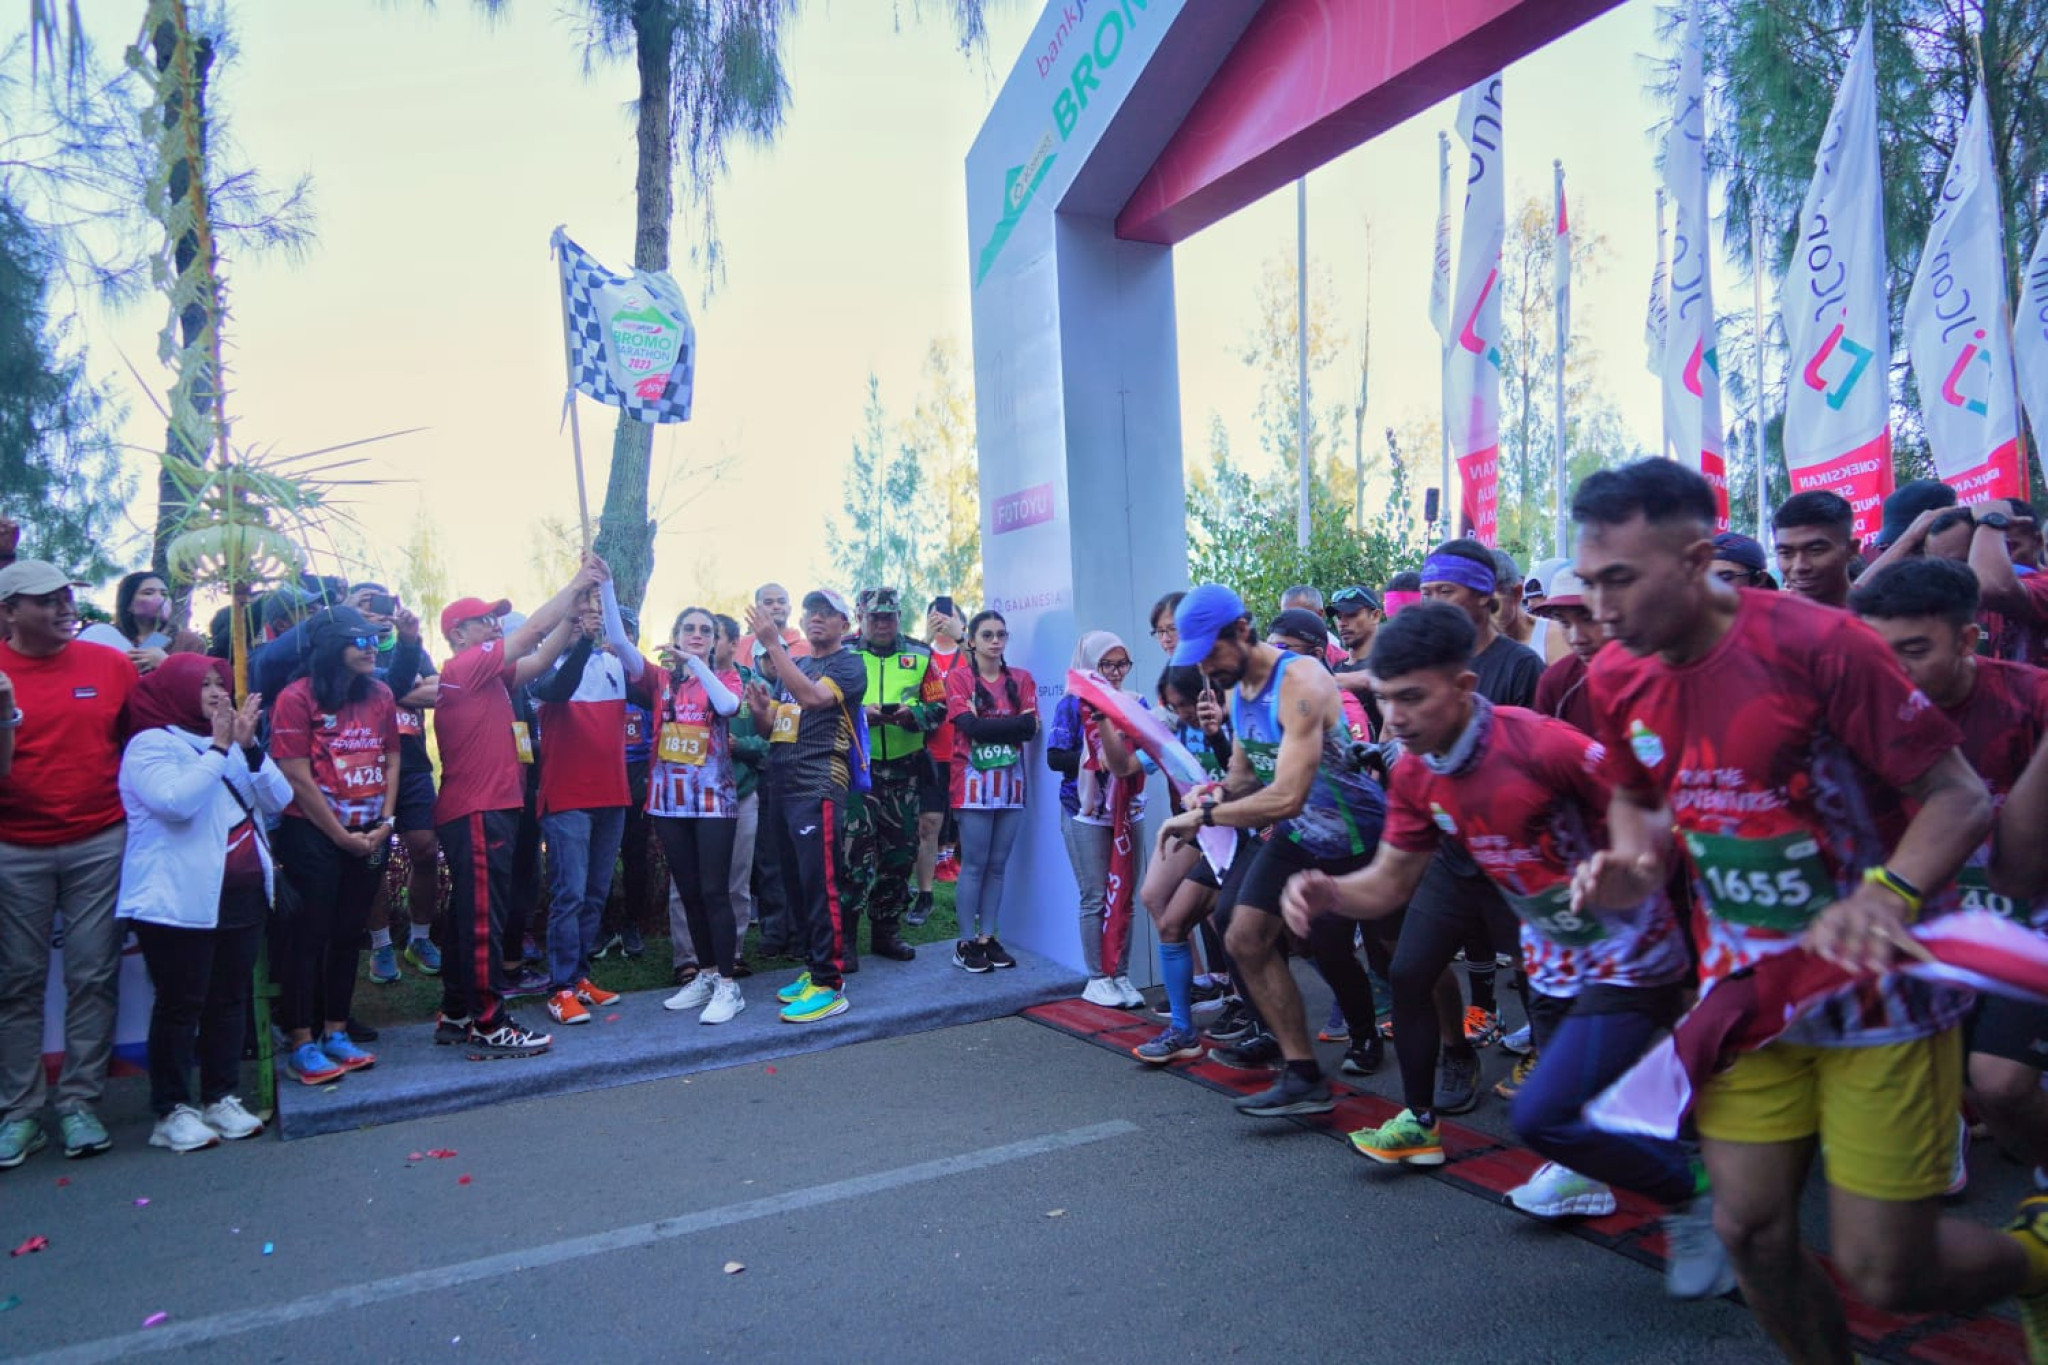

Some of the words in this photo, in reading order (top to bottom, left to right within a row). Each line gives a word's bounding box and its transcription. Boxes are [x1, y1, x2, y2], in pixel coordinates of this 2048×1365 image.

[613, 330, 672, 350] BROMO
[998, 493, 1048, 525] FOTOYU
[665, 736, 700, 755] 1813
[976, 744, 1013, 761] 1694
[344, 766, 383, 788] 1428
[1705, 865, 1812, 907] 1655
